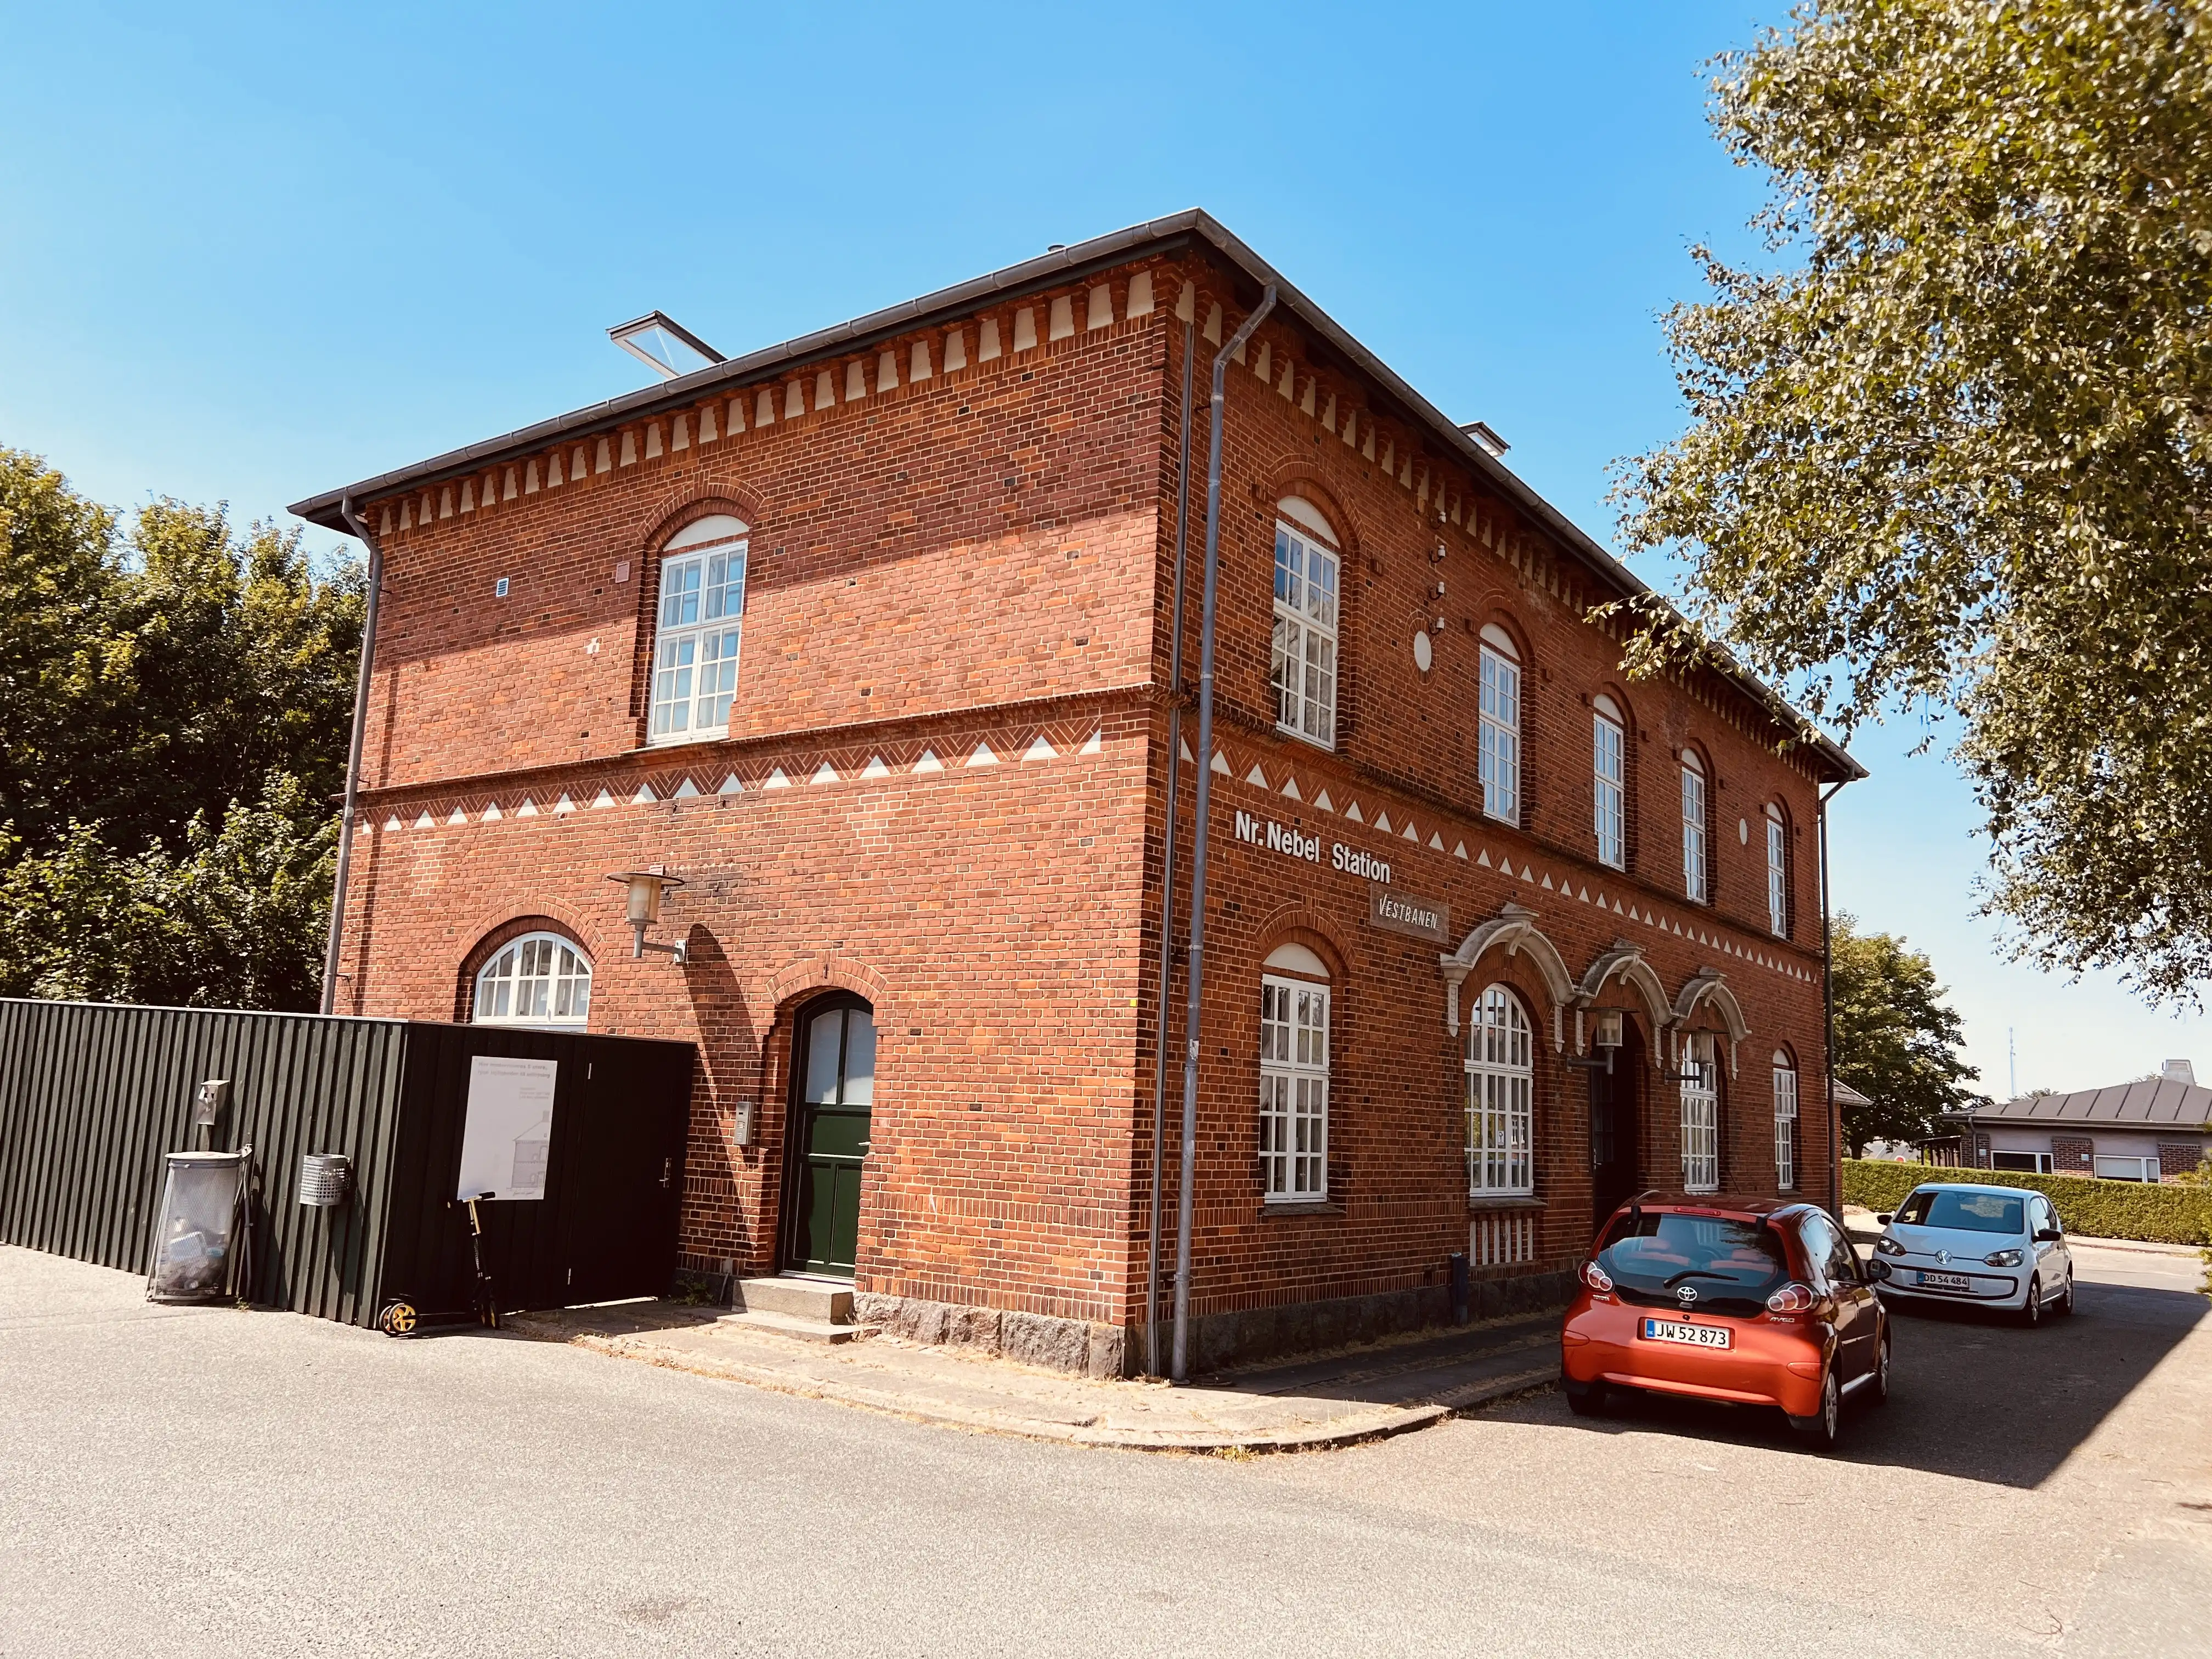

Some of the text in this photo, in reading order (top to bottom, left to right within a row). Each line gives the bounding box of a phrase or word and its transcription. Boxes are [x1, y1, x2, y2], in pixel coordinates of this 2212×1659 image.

[1235, 810, 1390, 884] Nr. Nebel Station
[1379, 893, 1438, 929] VESTBANEN
[1924, 1274, 1936, 1282] DD
[1938, 1276, 1949, 1284] 54
[1657, 1324, 1726, 1345] JW 52 873
